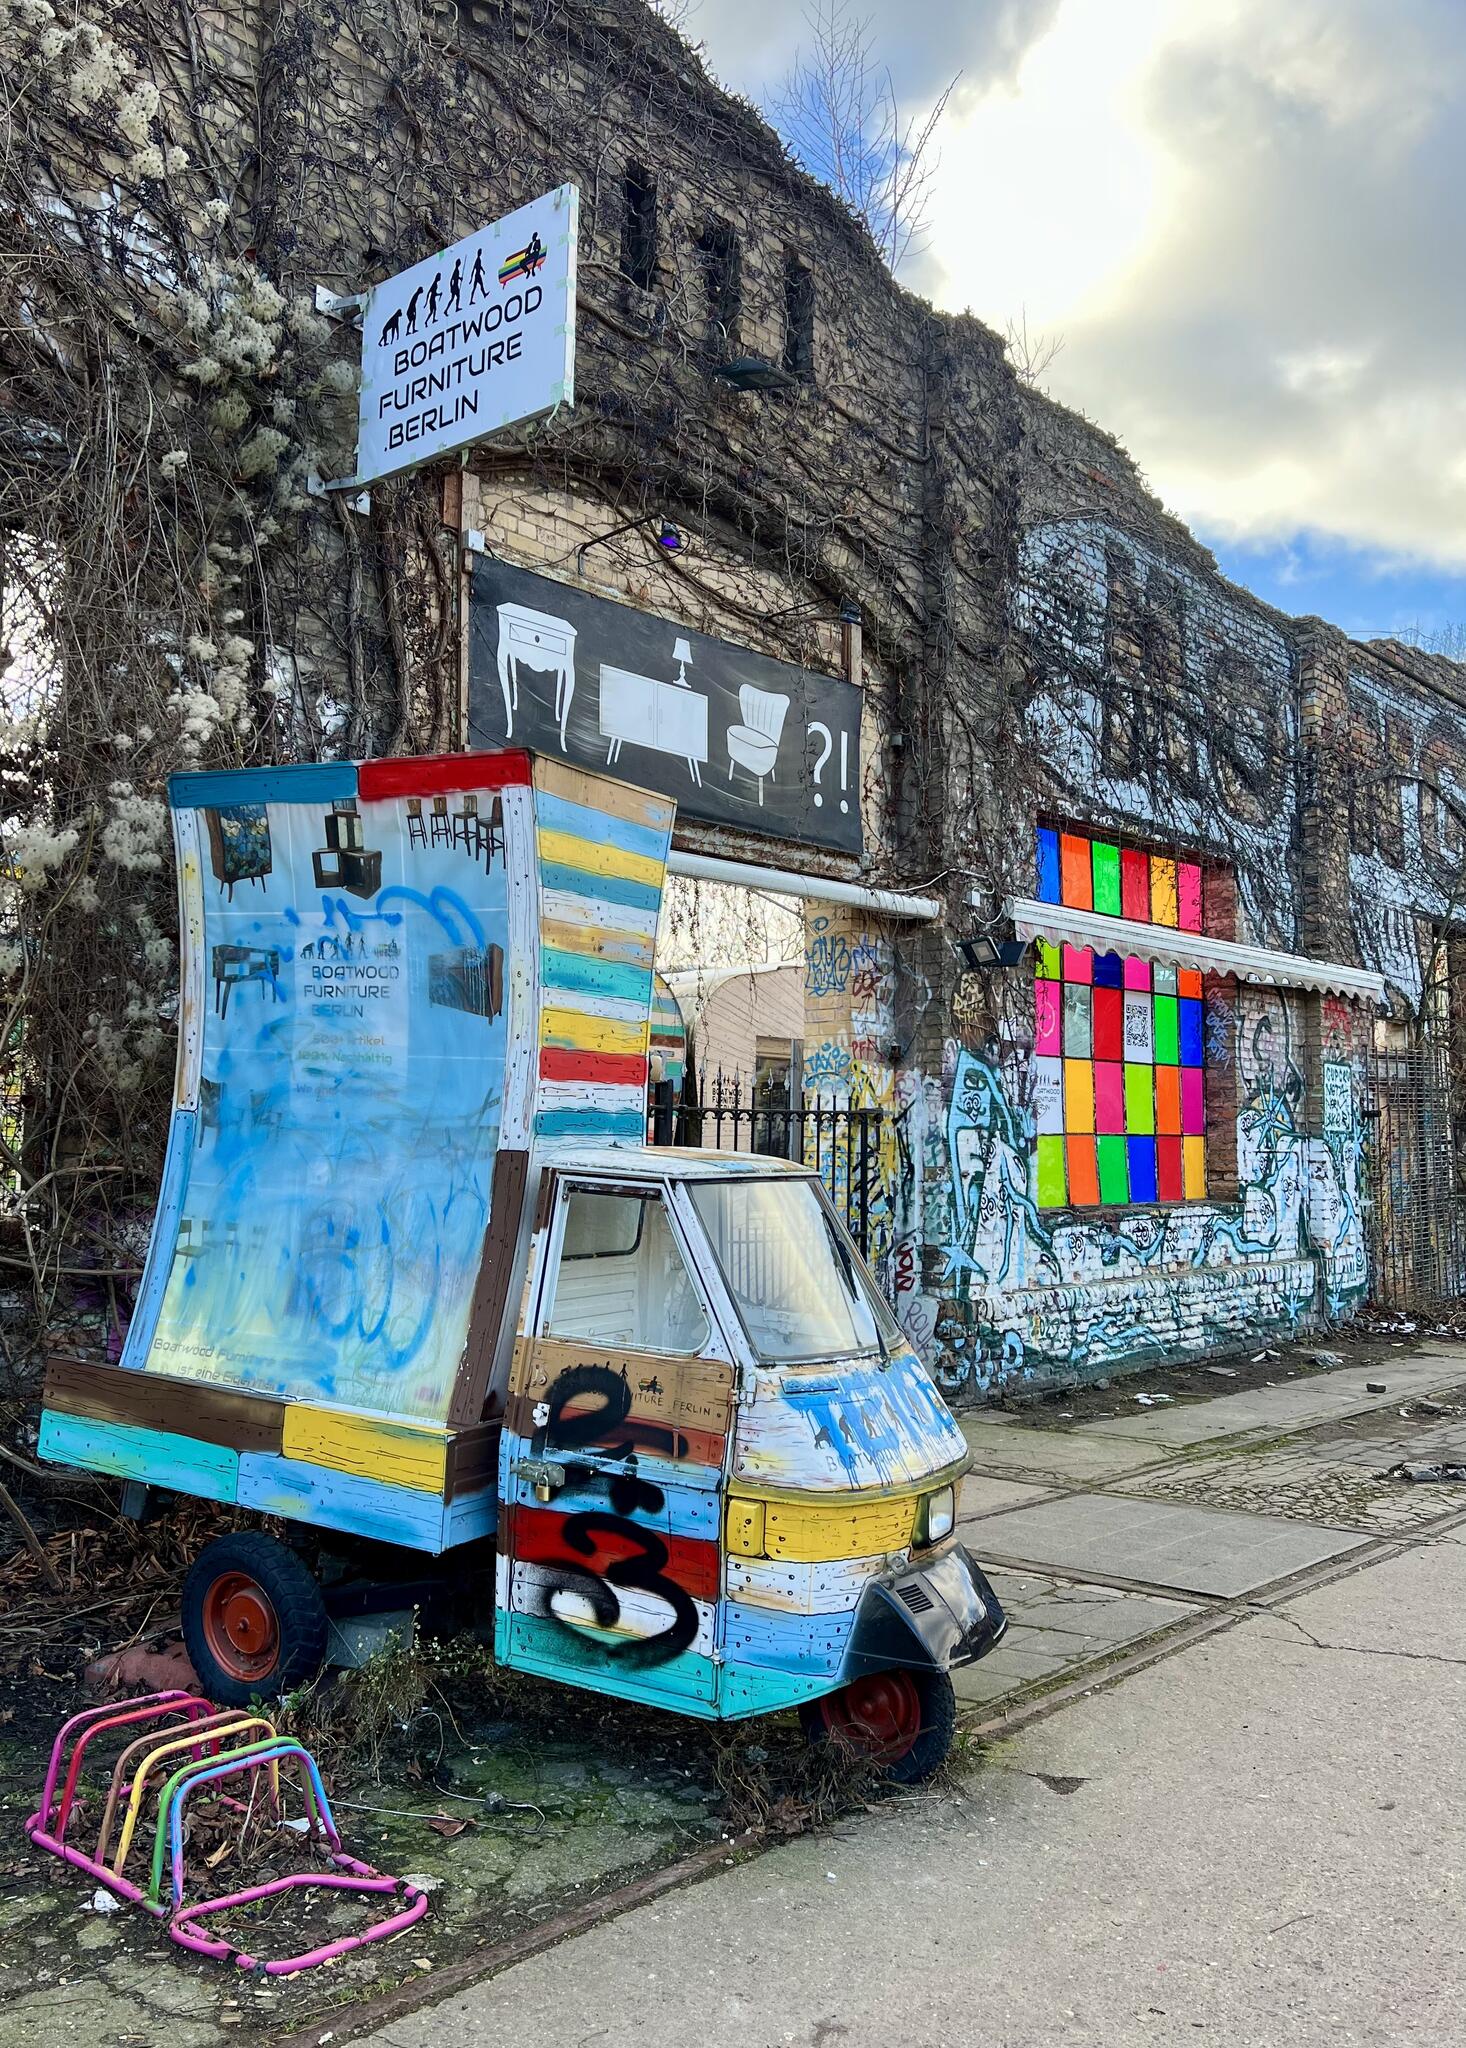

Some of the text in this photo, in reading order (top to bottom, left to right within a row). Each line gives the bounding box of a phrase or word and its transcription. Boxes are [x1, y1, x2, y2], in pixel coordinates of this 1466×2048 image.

[394, 285, 543, 377] BOATWOOD
[379, 331, 523, 420] FURNITURE
[312, 965, 400, 980] BOATWOOD
[304, 985, 391, 999] FURNITURE
[152, 1337, 215, 1358] Boatwood
[195, 1367, 220, 1382] eine
